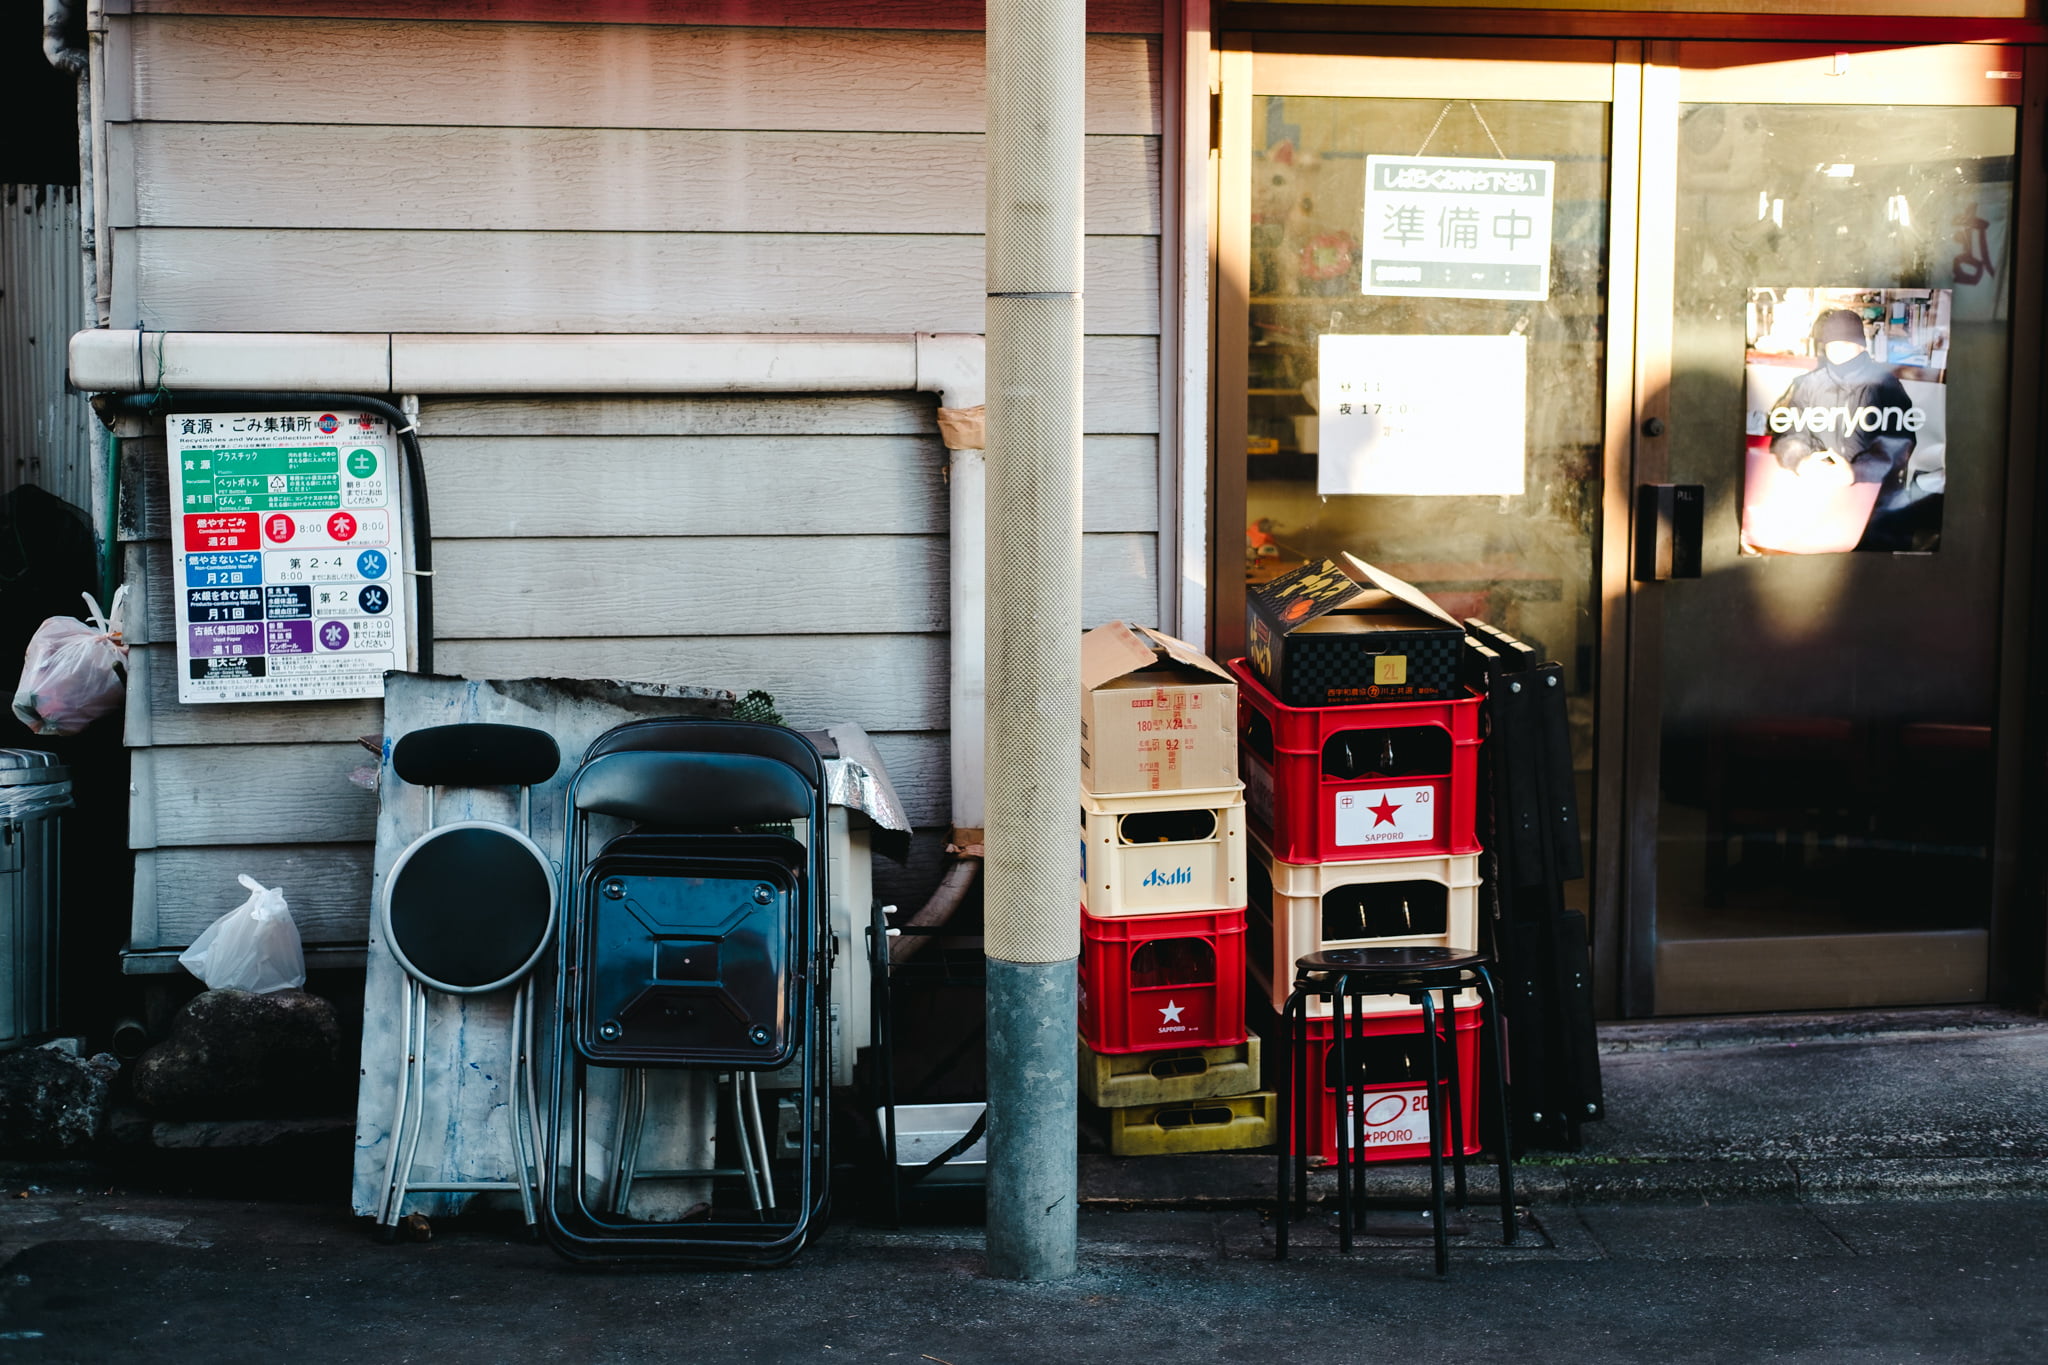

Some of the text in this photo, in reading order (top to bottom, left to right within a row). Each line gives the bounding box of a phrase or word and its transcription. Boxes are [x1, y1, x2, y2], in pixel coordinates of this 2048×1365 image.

[1383, 204, 1532, 251] 準備中
[1340, 403, 1352, 415] 夜
[181, 416, 312, 435] 資源・ごみ集積所
[1769, 405, 1926, 438] everyone
[217, 452, 258, 461] プラスチック
[354, 454, 370, 470] 土
[218, 478, 260, 487] ペットボトル
[197, 518, 247, 528] 燃やすごみ
[273, 519, 287, 535] 月
[300, 524, 322, 533] 8:00
[333, 517, 351, 533] 木
[362, 522, 384, 531] 8:00
[188, 554, 258, 565] 燃やさないごみ
[290, 558, 301, 569] 第
[363, 554, 380, 571] 火
[206, 572, 243, 584] 月2回
[280, 572, 303, 580] 8:00
[191, 589, 259, 601] 水銀を含む製品
[320, 591, 348, 604] 第 2
[365, 589, 382, 606] 火
[208, 607, 245, 620] 月1回
[325, 625, 342, 641] 水
[353, 640, 387, 648] しください
[1383, 663, 1399, 681] 2L
[1166, 739, 1179, 750] 9.2
[1341, 797, 1353, 808] 中
[1415, 791, 1430, 803] 20
[1365, 831, 1404, 842] SAPPORO
[1142, 866, 1192, 887] Asahi
[1158, 1025, 1186, 1034] SAPPORO
[1412, 1095, 1429, 1111] 20
